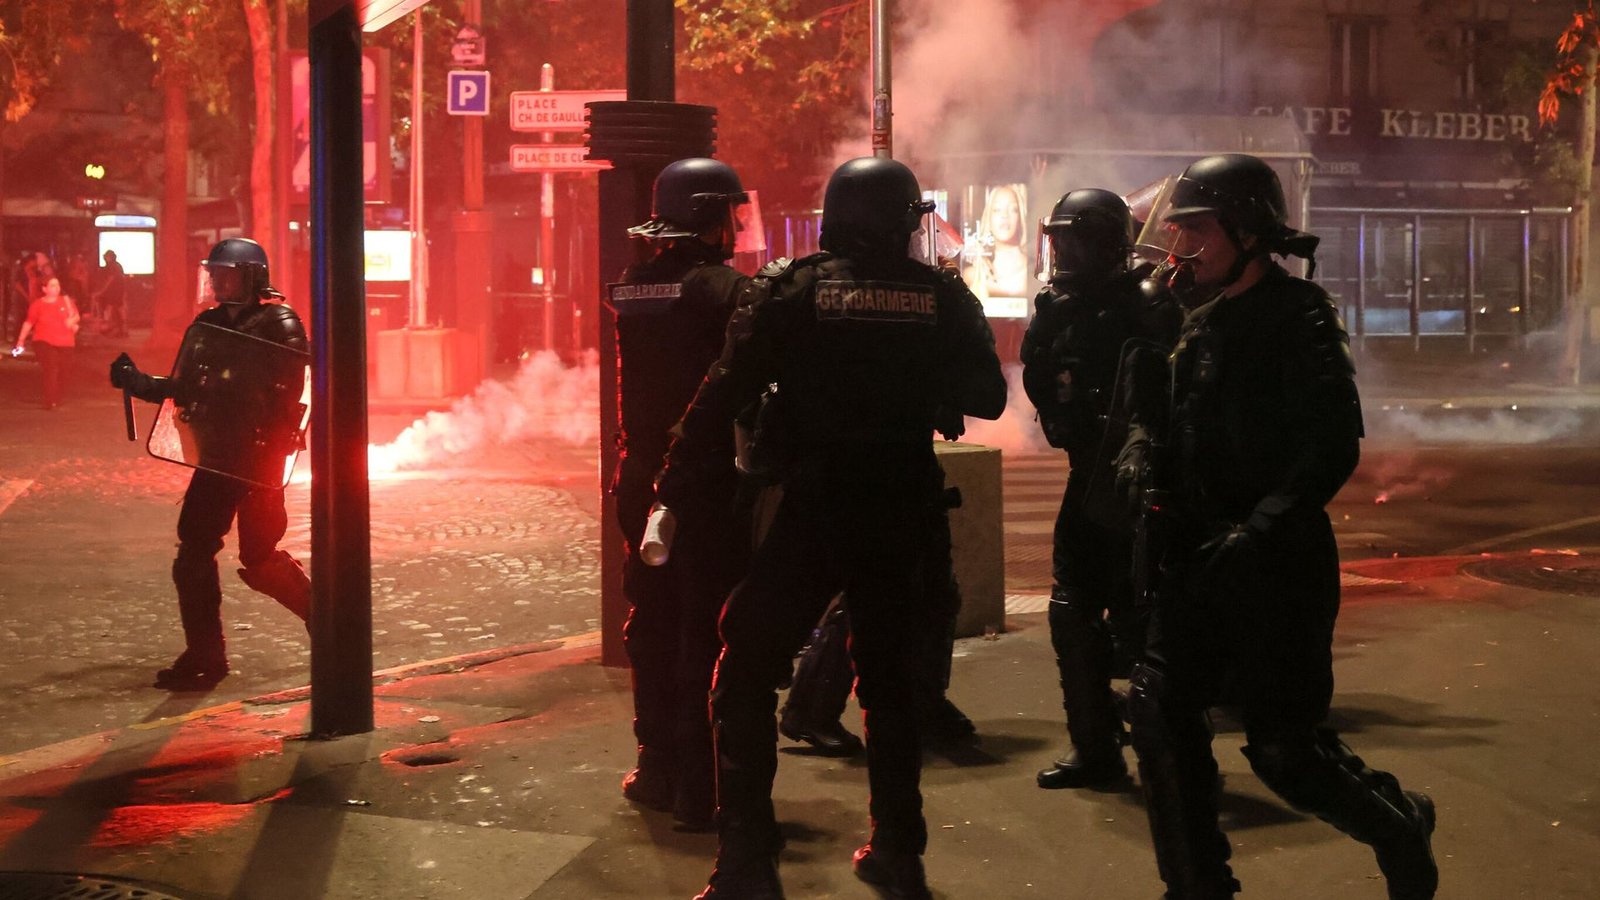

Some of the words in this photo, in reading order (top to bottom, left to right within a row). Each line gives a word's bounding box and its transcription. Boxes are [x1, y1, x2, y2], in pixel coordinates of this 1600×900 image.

[459, 79, 478, 106] P
[519, 100, 557, 109] PLACE
[536, 113, 549, 122] DE
[552, 112, 584, 122] GAULL
[1380, 108, 1533, 142] KLEBER
[518, 153, 550, 163] PLACE
[554, 153, 567, 162] DE
[571, 153, 583, 162] CL
[1310, 162, 1361, 175] EBER
[613, 284, 681, 301] GENDARMERIE
[816, 288, 935, 314] GENDARMERIE
